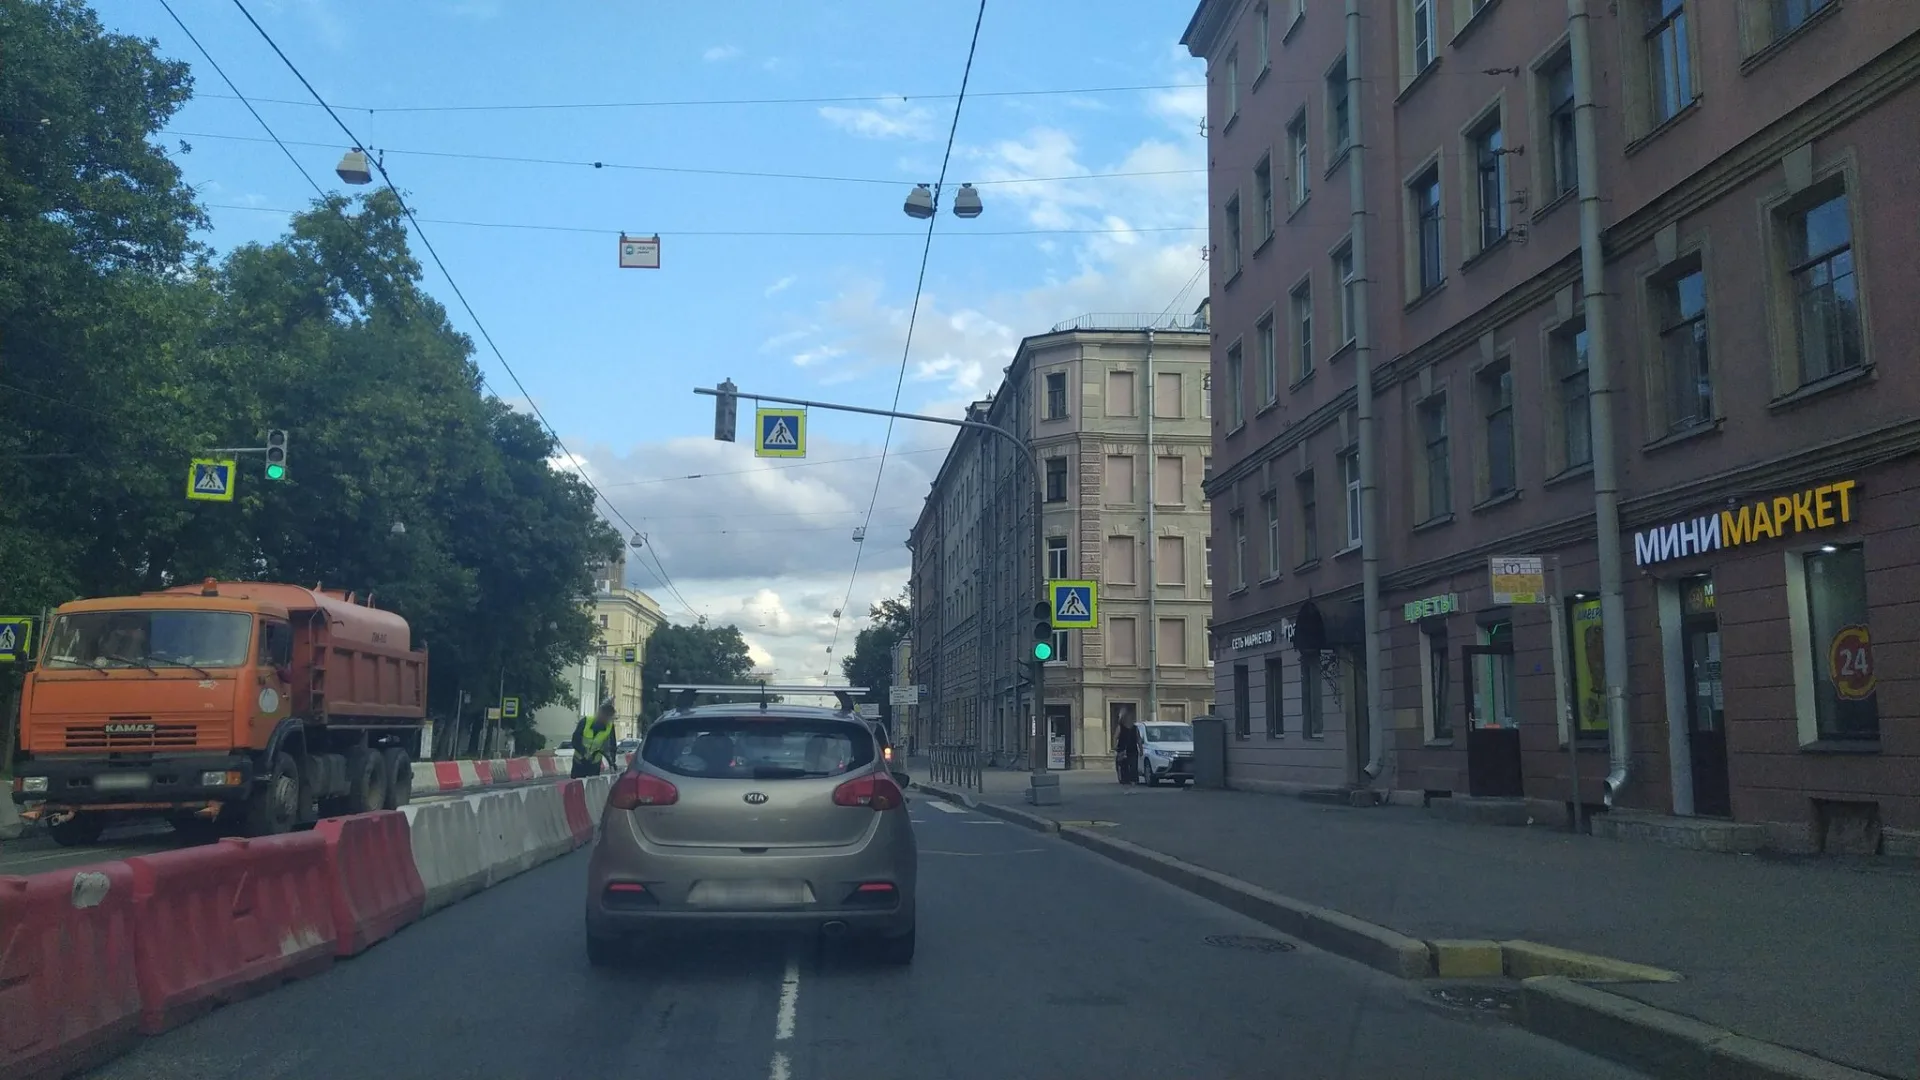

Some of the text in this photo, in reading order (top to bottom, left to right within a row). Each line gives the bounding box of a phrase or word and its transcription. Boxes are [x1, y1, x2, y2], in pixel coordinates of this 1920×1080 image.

[1404, 593, 1459, 623] ЦВЕТЫ
[1232, 630, 1272, 650] СЕТЬ МАРКЕТОВ
[1840, 647, 1869, 676] 24
[105, 724, 155, 733] KAMAZ
[747, 793, 765, 802] KIA
